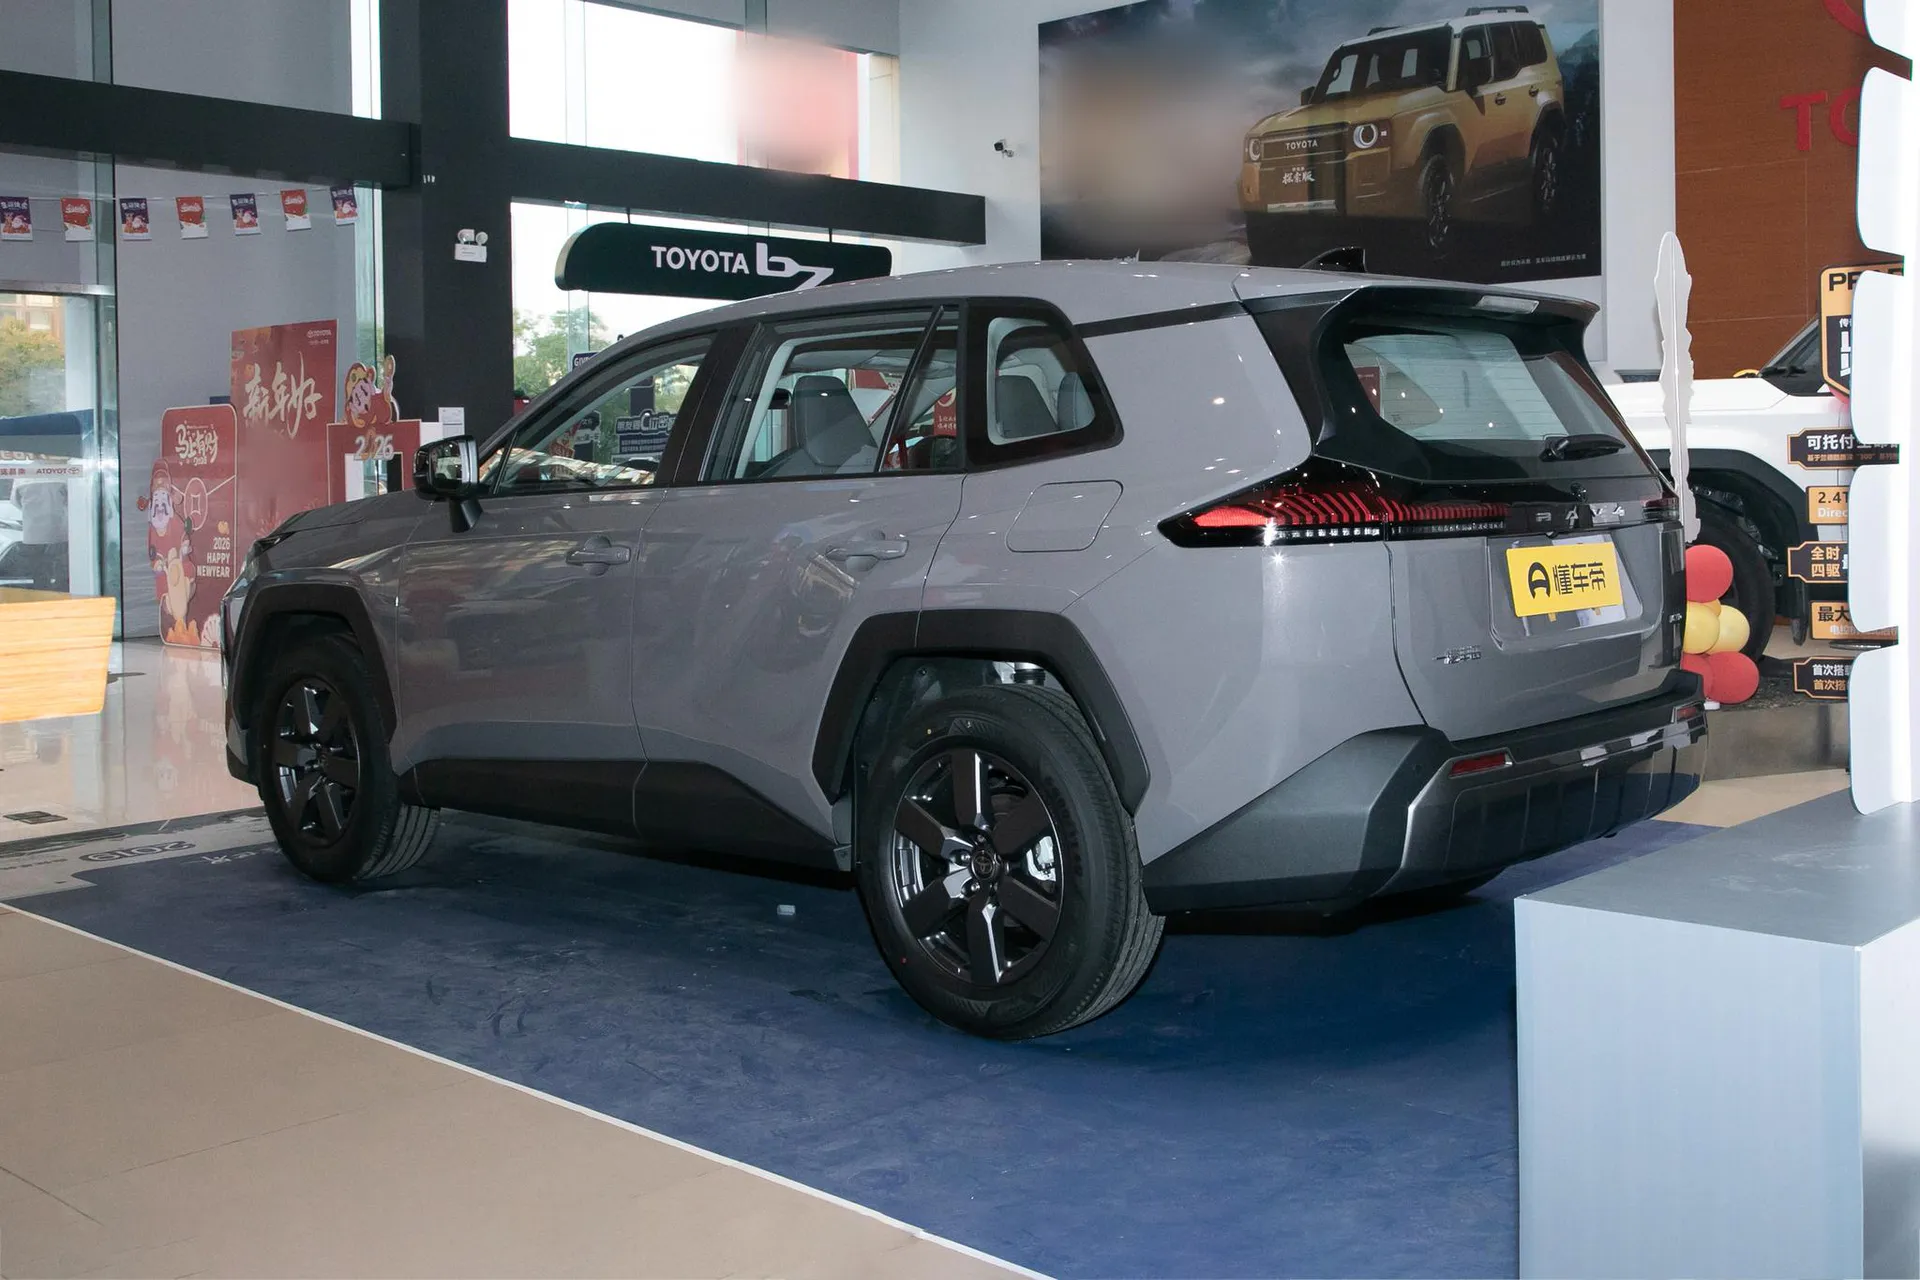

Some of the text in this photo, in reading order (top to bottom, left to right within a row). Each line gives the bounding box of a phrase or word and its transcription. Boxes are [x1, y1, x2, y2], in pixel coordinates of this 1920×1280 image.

[1286, 140, 1318, 150] TOYOTA
[651, 246, 750, 274] TOYOTA
[213, 537, 230, 550] 2026
[206, 552, 231, 564] HAPPY
[1811, 546, 1840, 561] 全时
[1811, 563, 1841, 578] 四驱
[1552, 562, 1606, 595] 懂车帝
[1818, 606, 1850, 622] 最大
[1814, 679, 1849, 691] 首次搭
